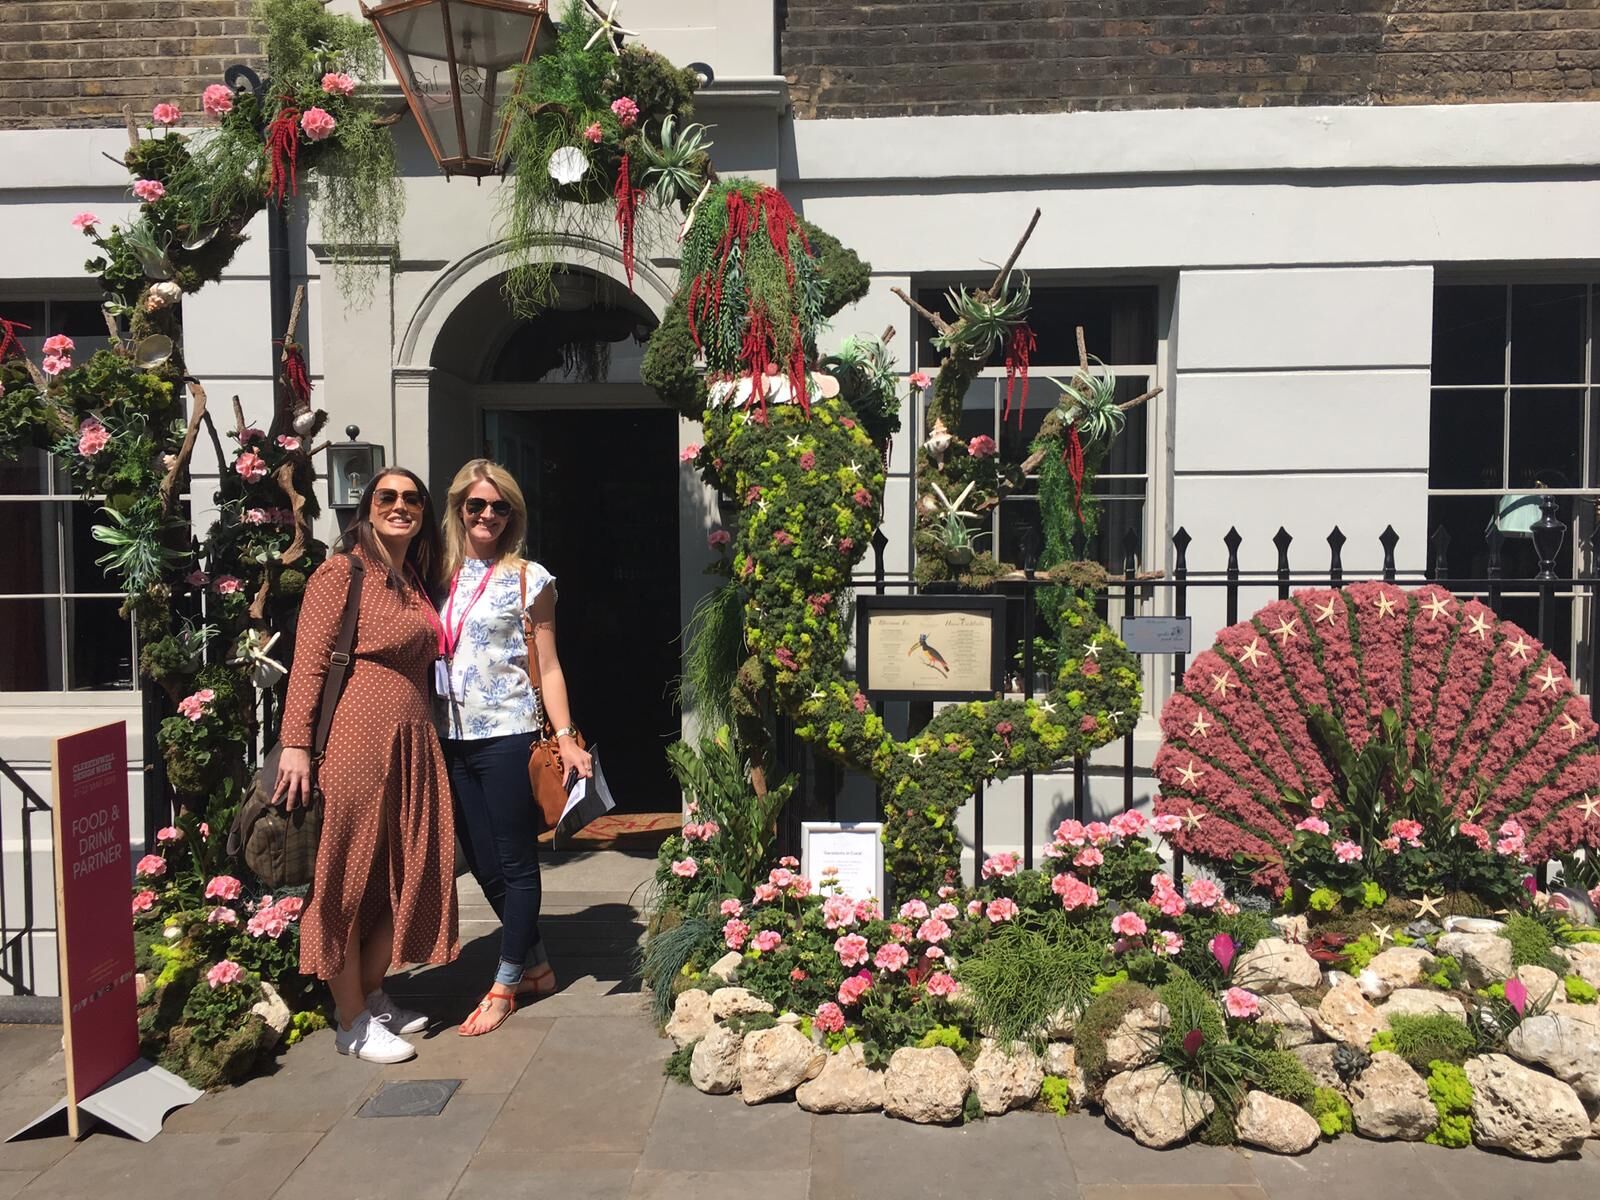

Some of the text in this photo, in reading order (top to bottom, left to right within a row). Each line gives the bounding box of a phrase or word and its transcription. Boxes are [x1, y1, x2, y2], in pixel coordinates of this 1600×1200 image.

[72, 804, 120, 838] FOOD &
[79, 825, 116, 856] DRINK
[72, 843, 123, 880] PARTNER
